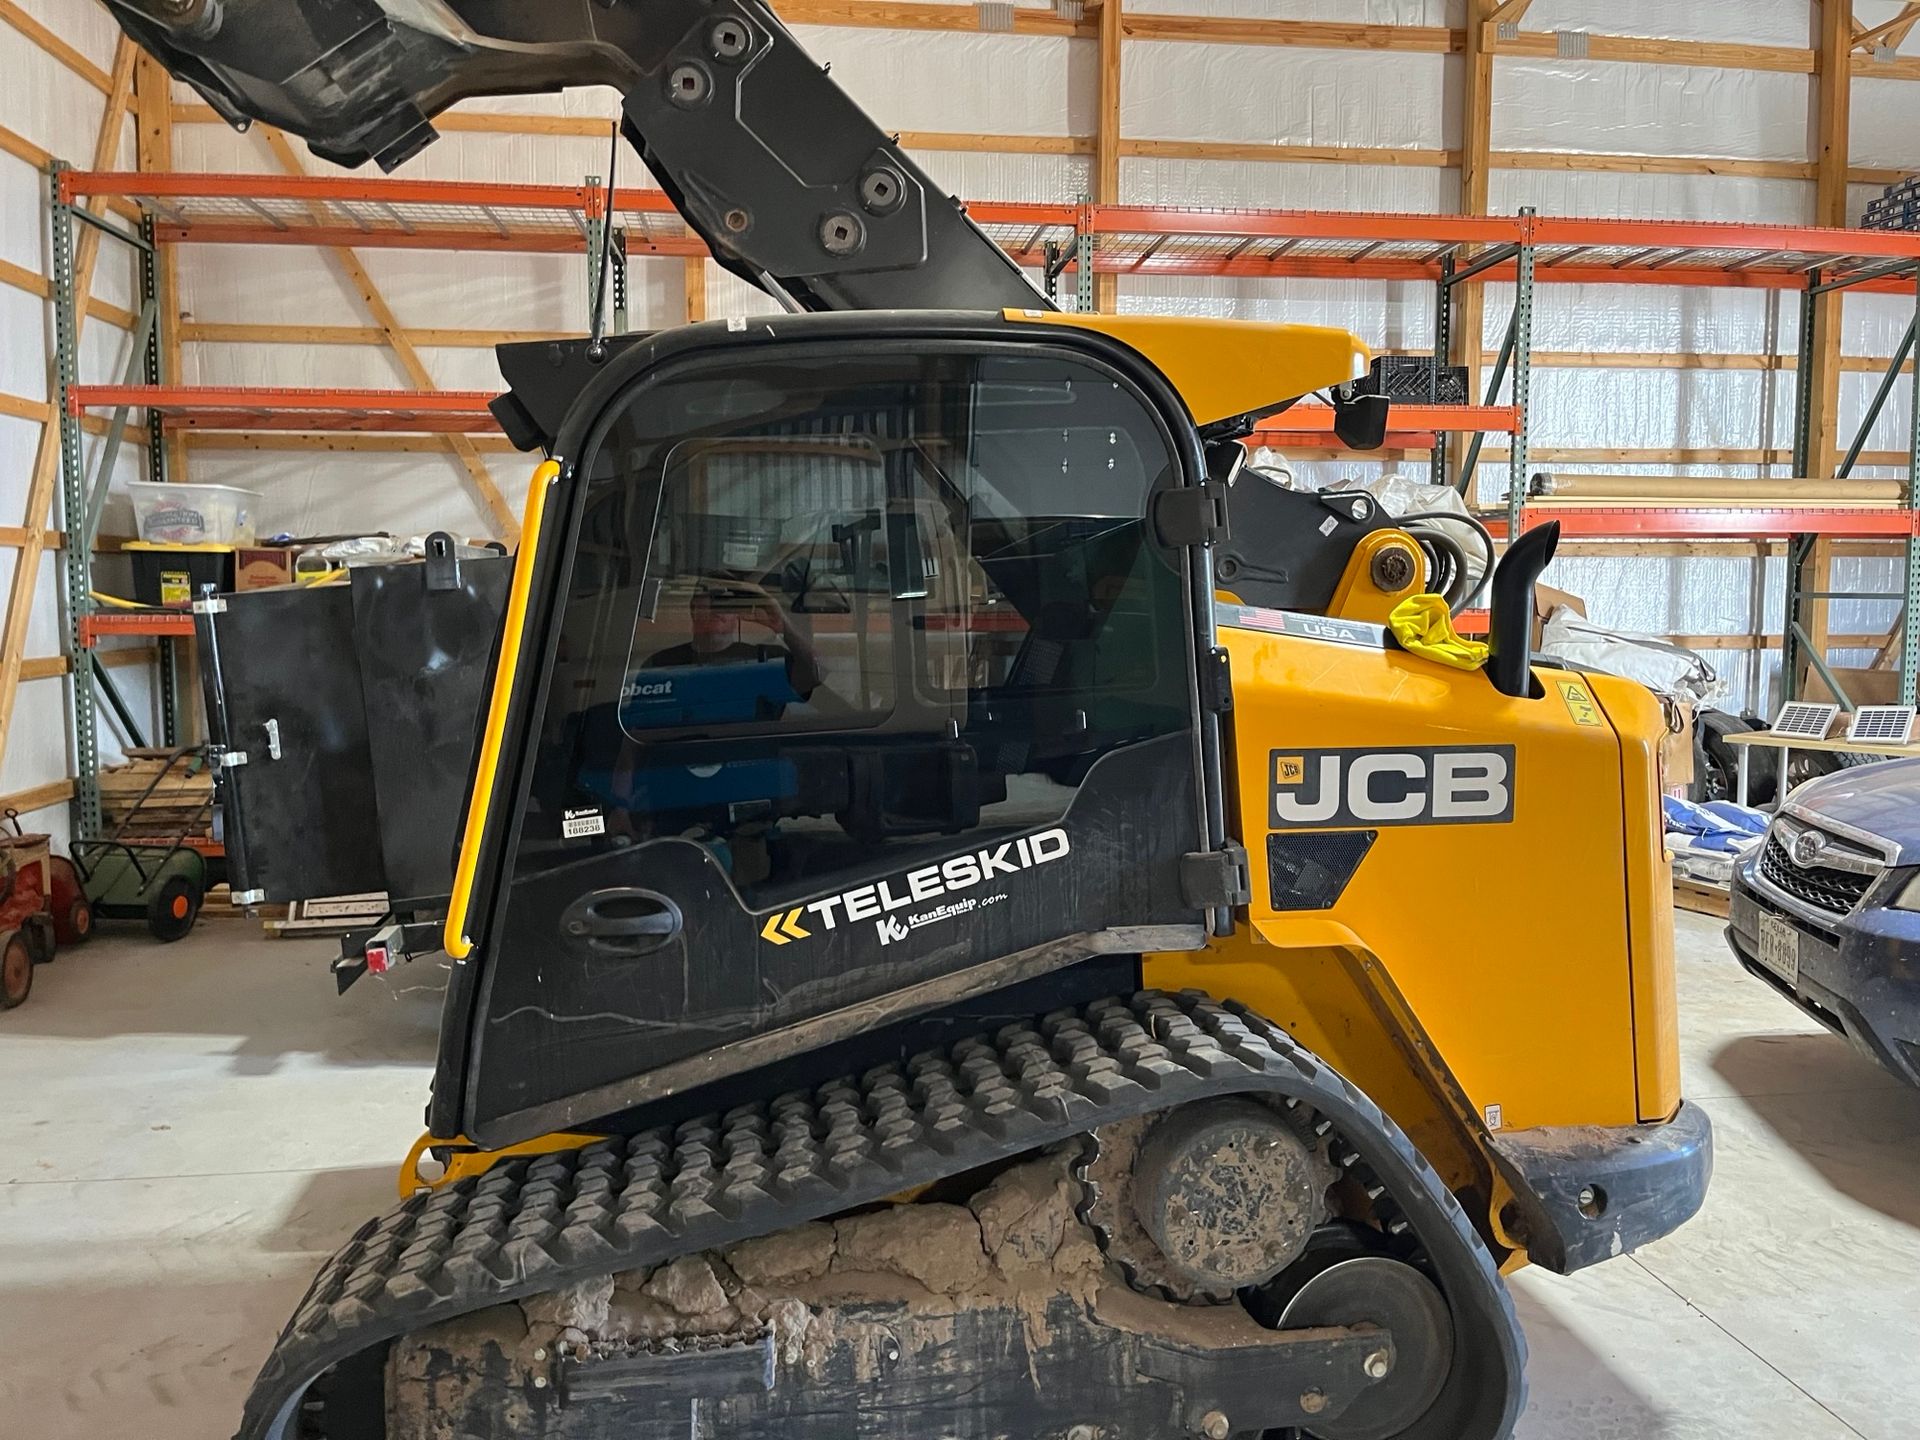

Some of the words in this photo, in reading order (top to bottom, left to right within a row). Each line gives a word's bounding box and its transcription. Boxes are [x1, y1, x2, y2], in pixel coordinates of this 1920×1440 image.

[1303, 623, 1356, 640] USA
[622, 680, 672, 697] obcat
[1276, 752, 1508, 822] JCB
[807, 828, 1070, 930] TELESKID
